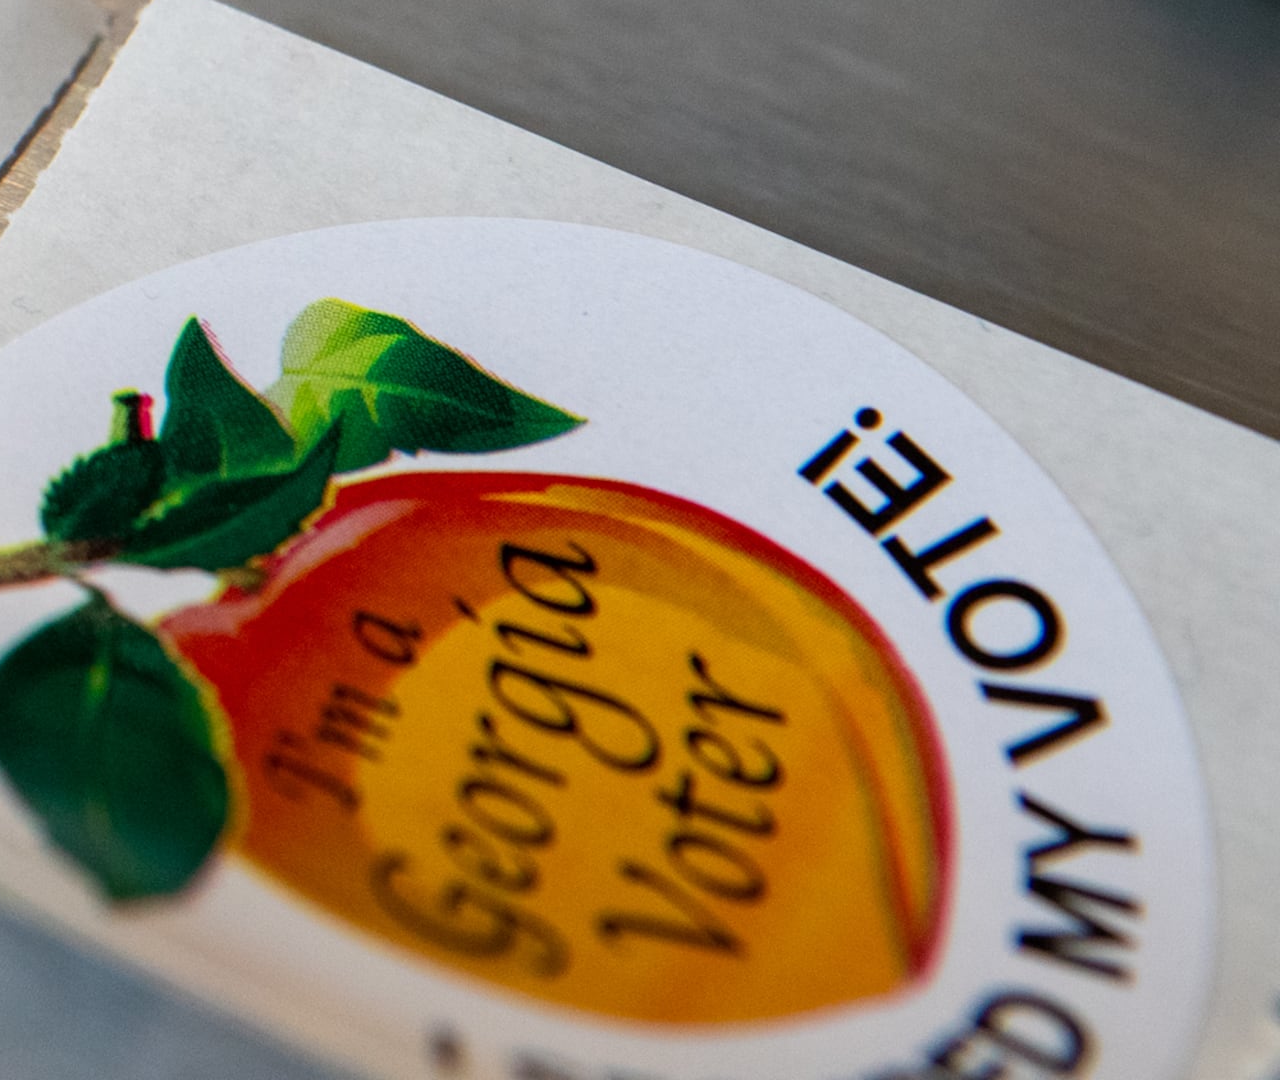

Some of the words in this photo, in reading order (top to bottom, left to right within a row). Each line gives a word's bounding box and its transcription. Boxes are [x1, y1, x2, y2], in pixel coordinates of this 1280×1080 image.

[352, 610, 426, 668] a
[796, 407, 1109, 766] VOTE!
[370, 538, 662, 980] Georgia
[596, 653, 788, 959] Voter
[1011, 791, 1145, 986] MY
